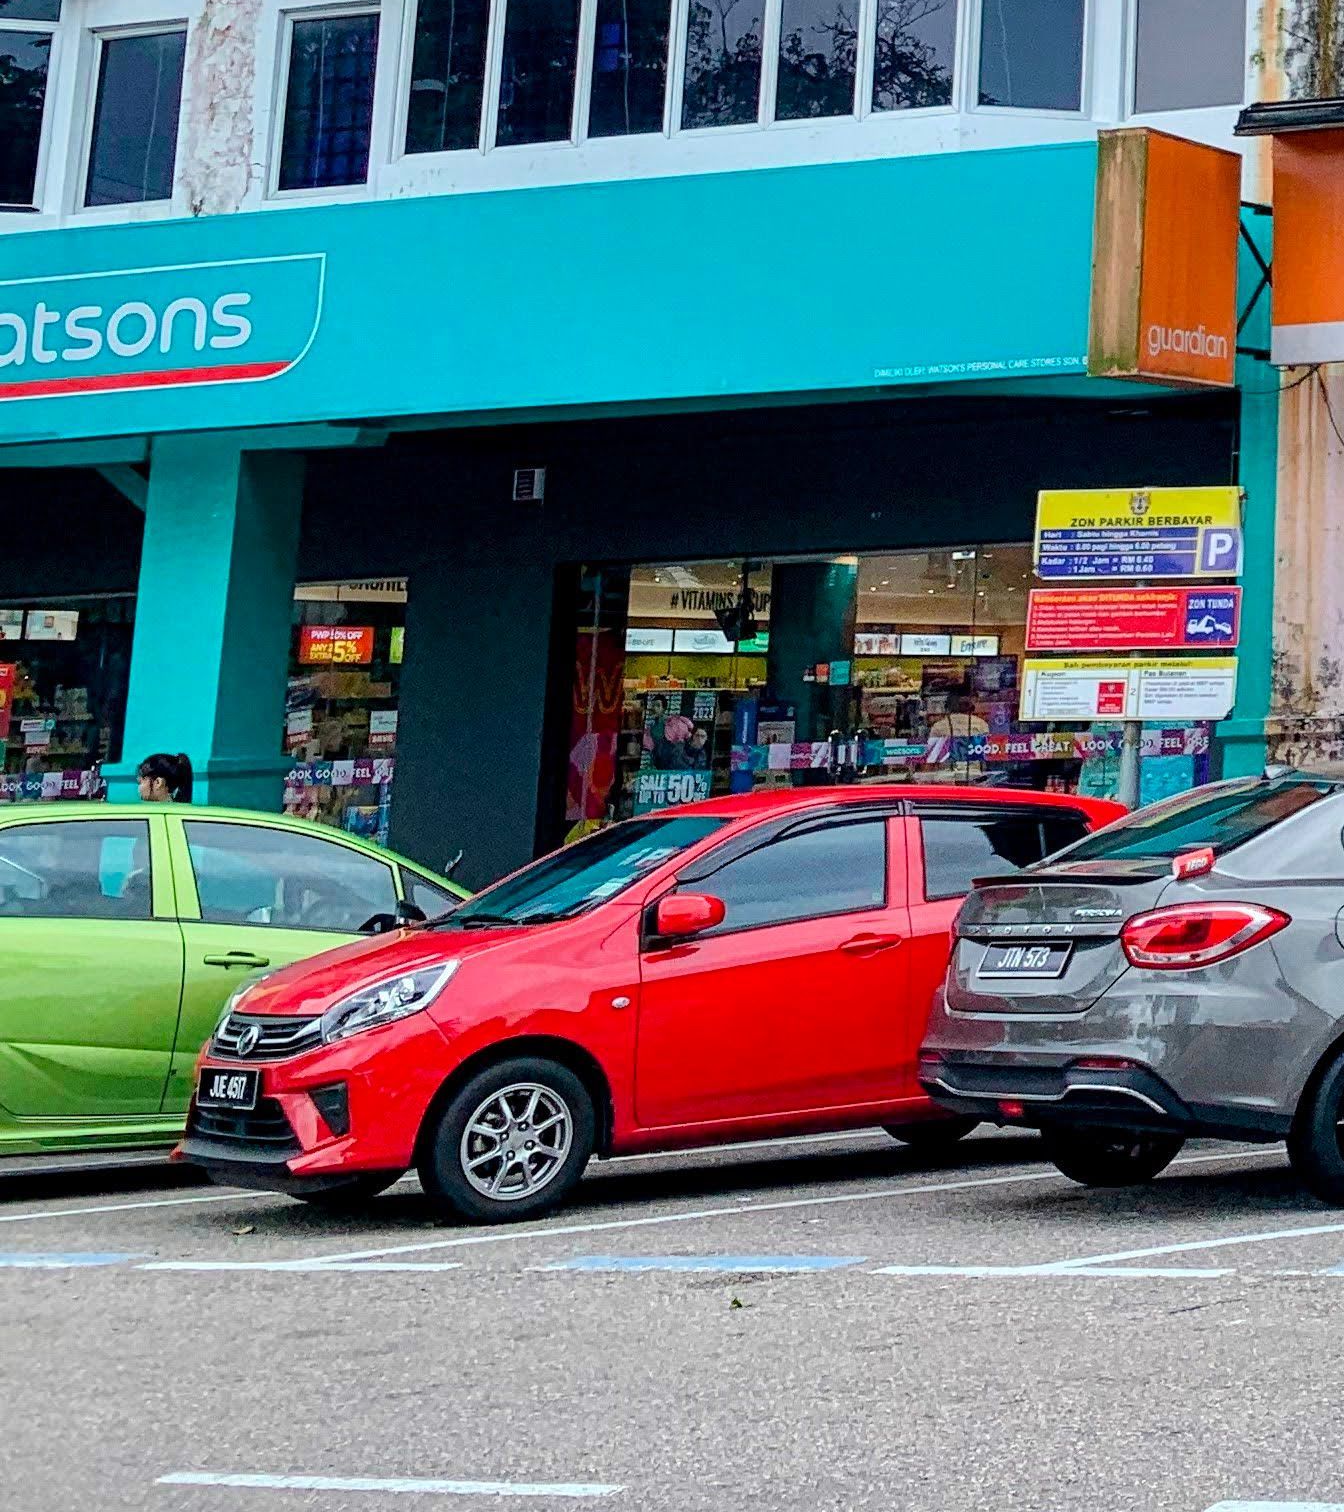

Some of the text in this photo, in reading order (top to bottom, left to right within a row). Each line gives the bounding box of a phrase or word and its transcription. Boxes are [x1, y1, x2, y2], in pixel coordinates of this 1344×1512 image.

[1148, 324, 1228, 359] guardian
[1071, 515, 1213, 528] ZON PARKIR BERBAYAR
[1208, 532, 1234, 567] P
[1188, 597, 1234, 609] ZON TUNDA
